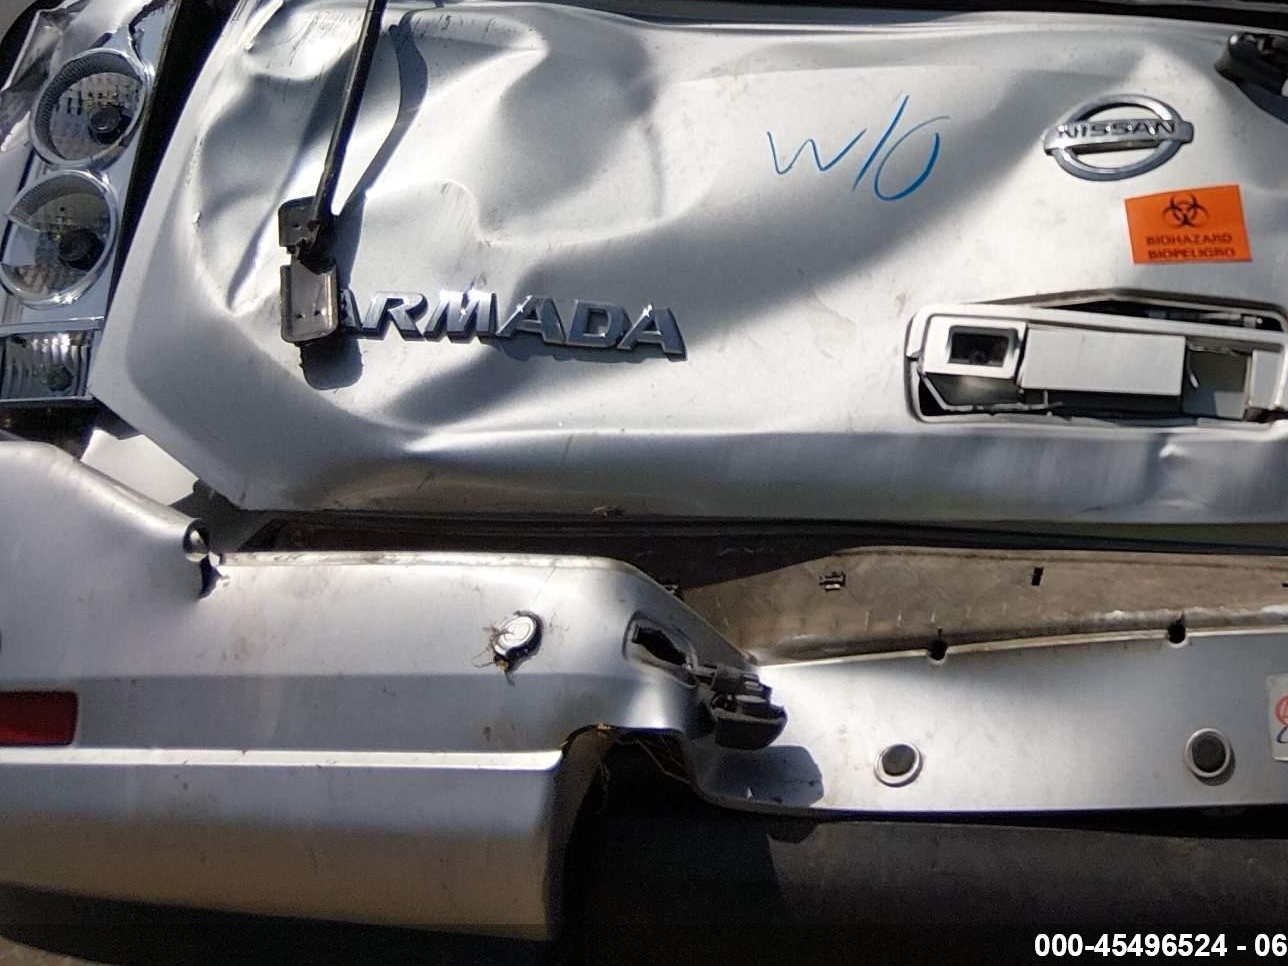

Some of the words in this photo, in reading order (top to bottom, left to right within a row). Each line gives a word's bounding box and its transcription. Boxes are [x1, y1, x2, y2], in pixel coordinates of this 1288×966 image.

[1057, 120, 1176, 139] NISSAN
[1145, 233, 1233, 247] BIOHAZARD
[1148, 248, 1236, 260] BIOPELIGRO
